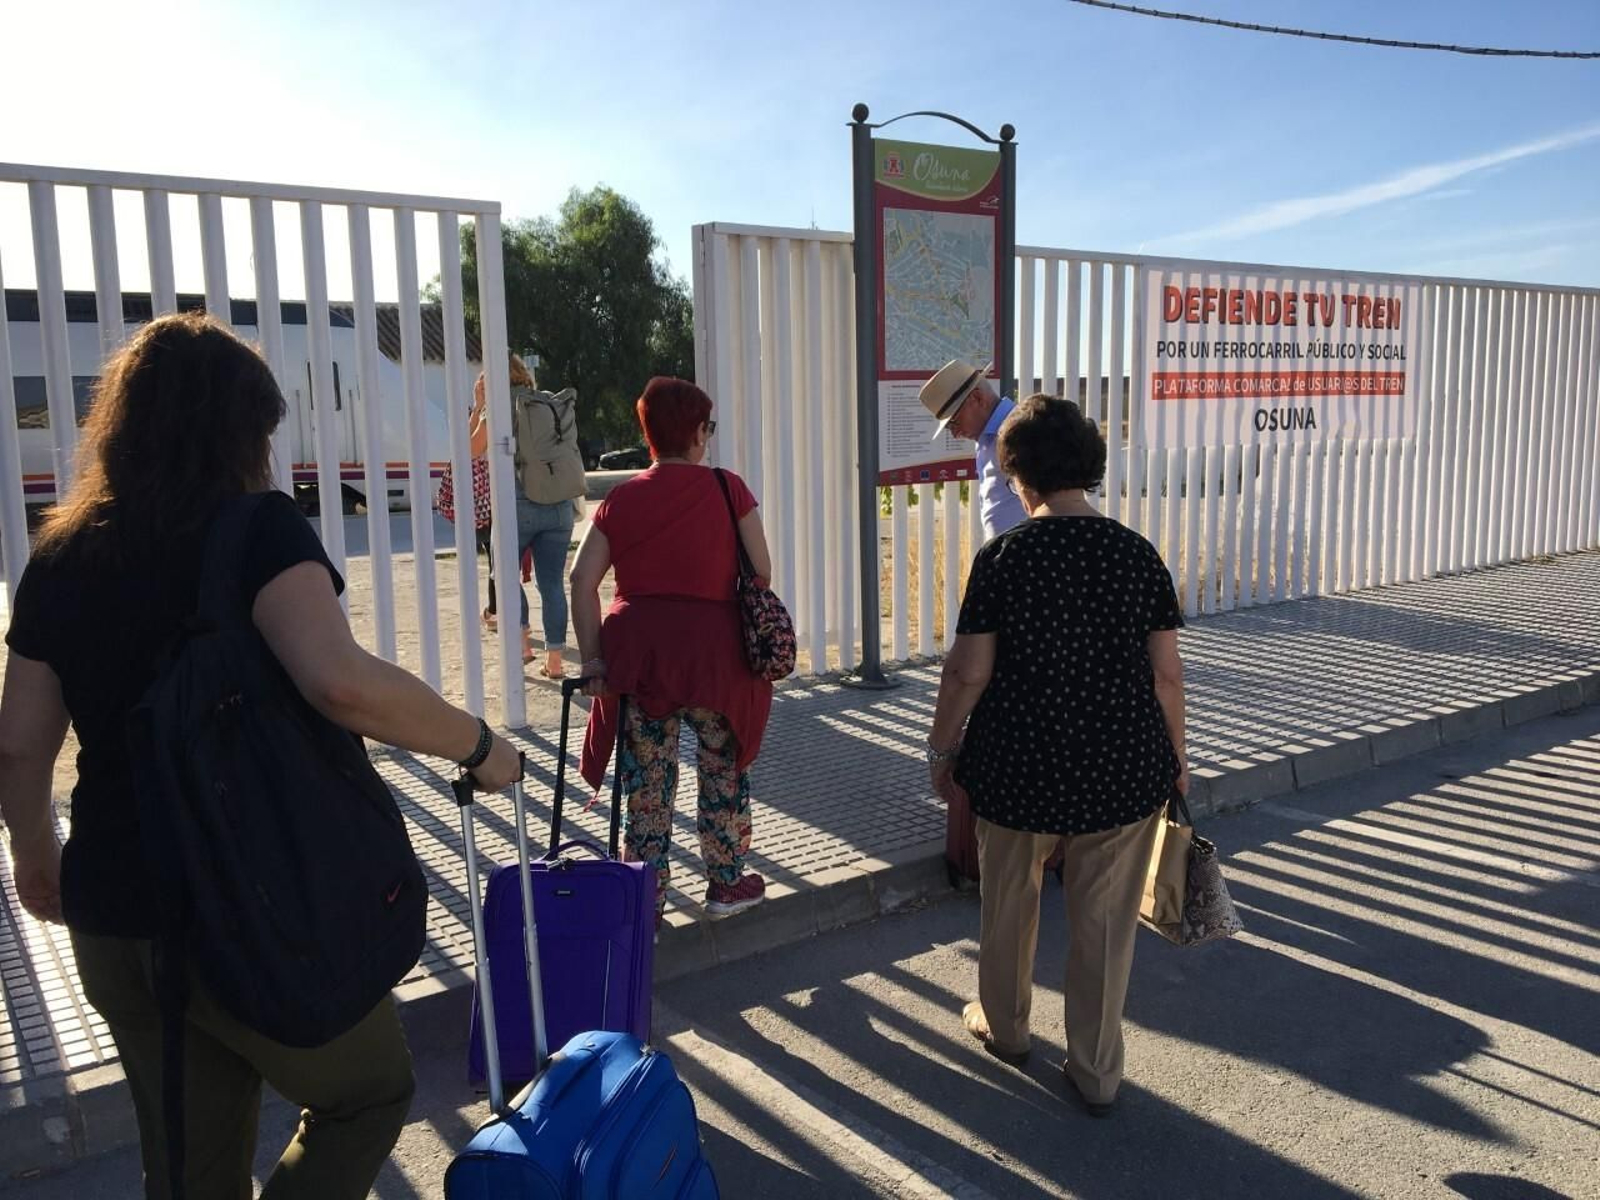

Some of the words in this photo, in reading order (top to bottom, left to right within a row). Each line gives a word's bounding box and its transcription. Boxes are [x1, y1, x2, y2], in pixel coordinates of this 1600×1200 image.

[913, 152, 971, 180] Osuna
[1163, 285, 1297, 326] DEFIENDE
[1303, 292, 1336, 328] TU
[1341, 294, 1401, 330] TREN
[1156, 341, 1186, 359] POR
[1190, 341, 1209, 358] UN
[1214, 341, 1304, 359] FERROCARRIL
[1306, 338, 1356, 360] PÚBLICO
[1359, 343, 1366, 359] Y
[1367, 344, 1407, 361] SOCIAL
[1154, 379, 1232, 395] PLATAFORMA
[1233, 377, 1291, 392] COMARCAL
[1293, 376, 1306, 391] de
[1308, 376, 1359, 394] USUARI@S
[1360, 377, 1377, 391] DEL
[1379, 377, 1404, 391] TREN
[1254, 407, 1317, 433] OSUNA
